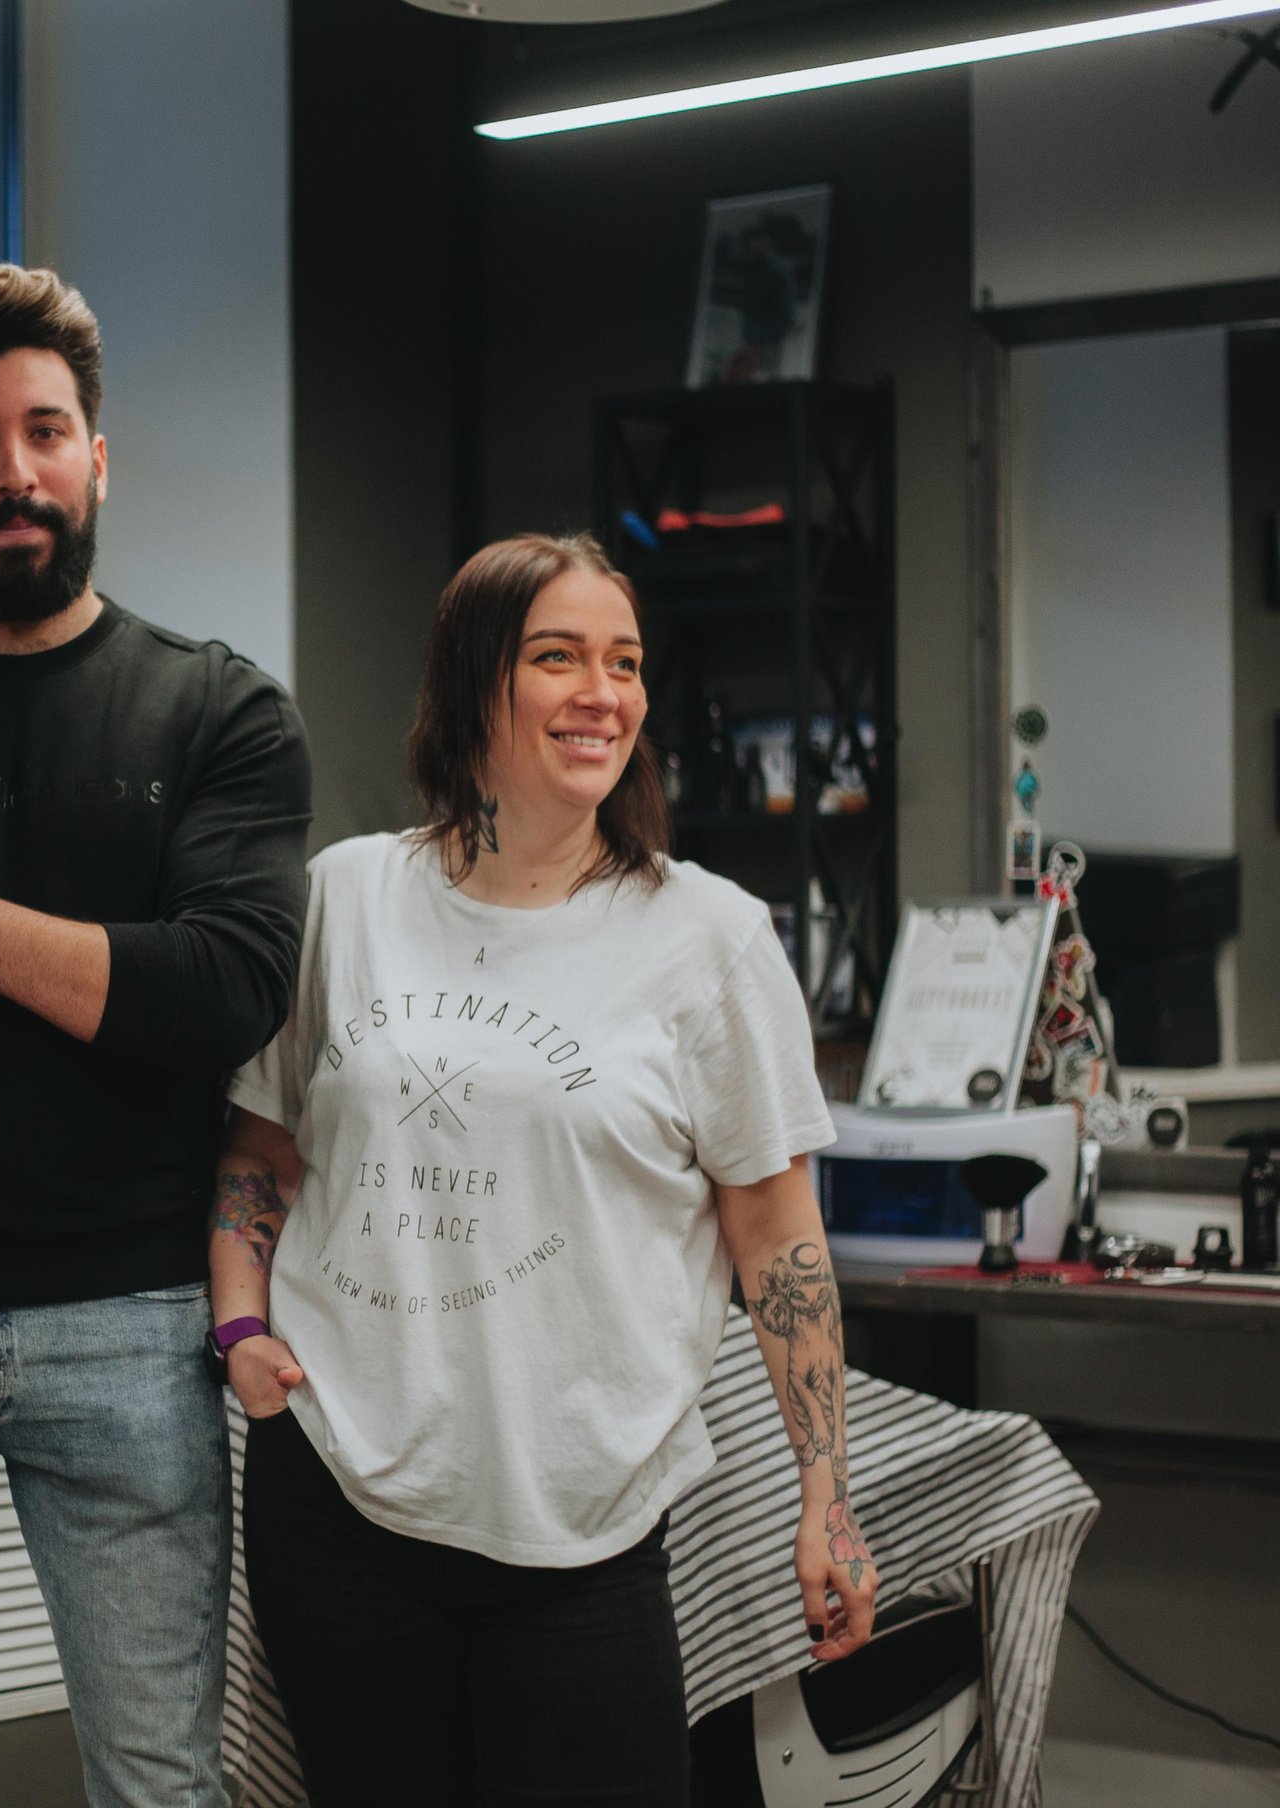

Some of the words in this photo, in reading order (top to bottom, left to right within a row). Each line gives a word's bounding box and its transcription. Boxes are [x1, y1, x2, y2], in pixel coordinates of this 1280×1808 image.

[473, 946, 486, 966] A
[325, 992, 597, 1093] DESTINATION
[434, 1056, 448, 1074] N
[400, 1076, 411, 1097] W
[463, 1082, 474, 1102] E
[428, 1109, 439, 1130] S
[357, 1162, 387, 1188] IS
[410, 1165, 498, 1197] NEVER
[360, 1211, 372, 1237] A
[397, 1213, 480, 1244] PLACE
[321, 1260, 331, 1275] A
[333, 1271, 363, 1299] NEW
[369, 1289, 398, 1312] WAY
[407, 1297, 429, 1315] OF
[440, 1279, 498, 1314] SEEING
[504, 1233, 566, 1285] THINGS
